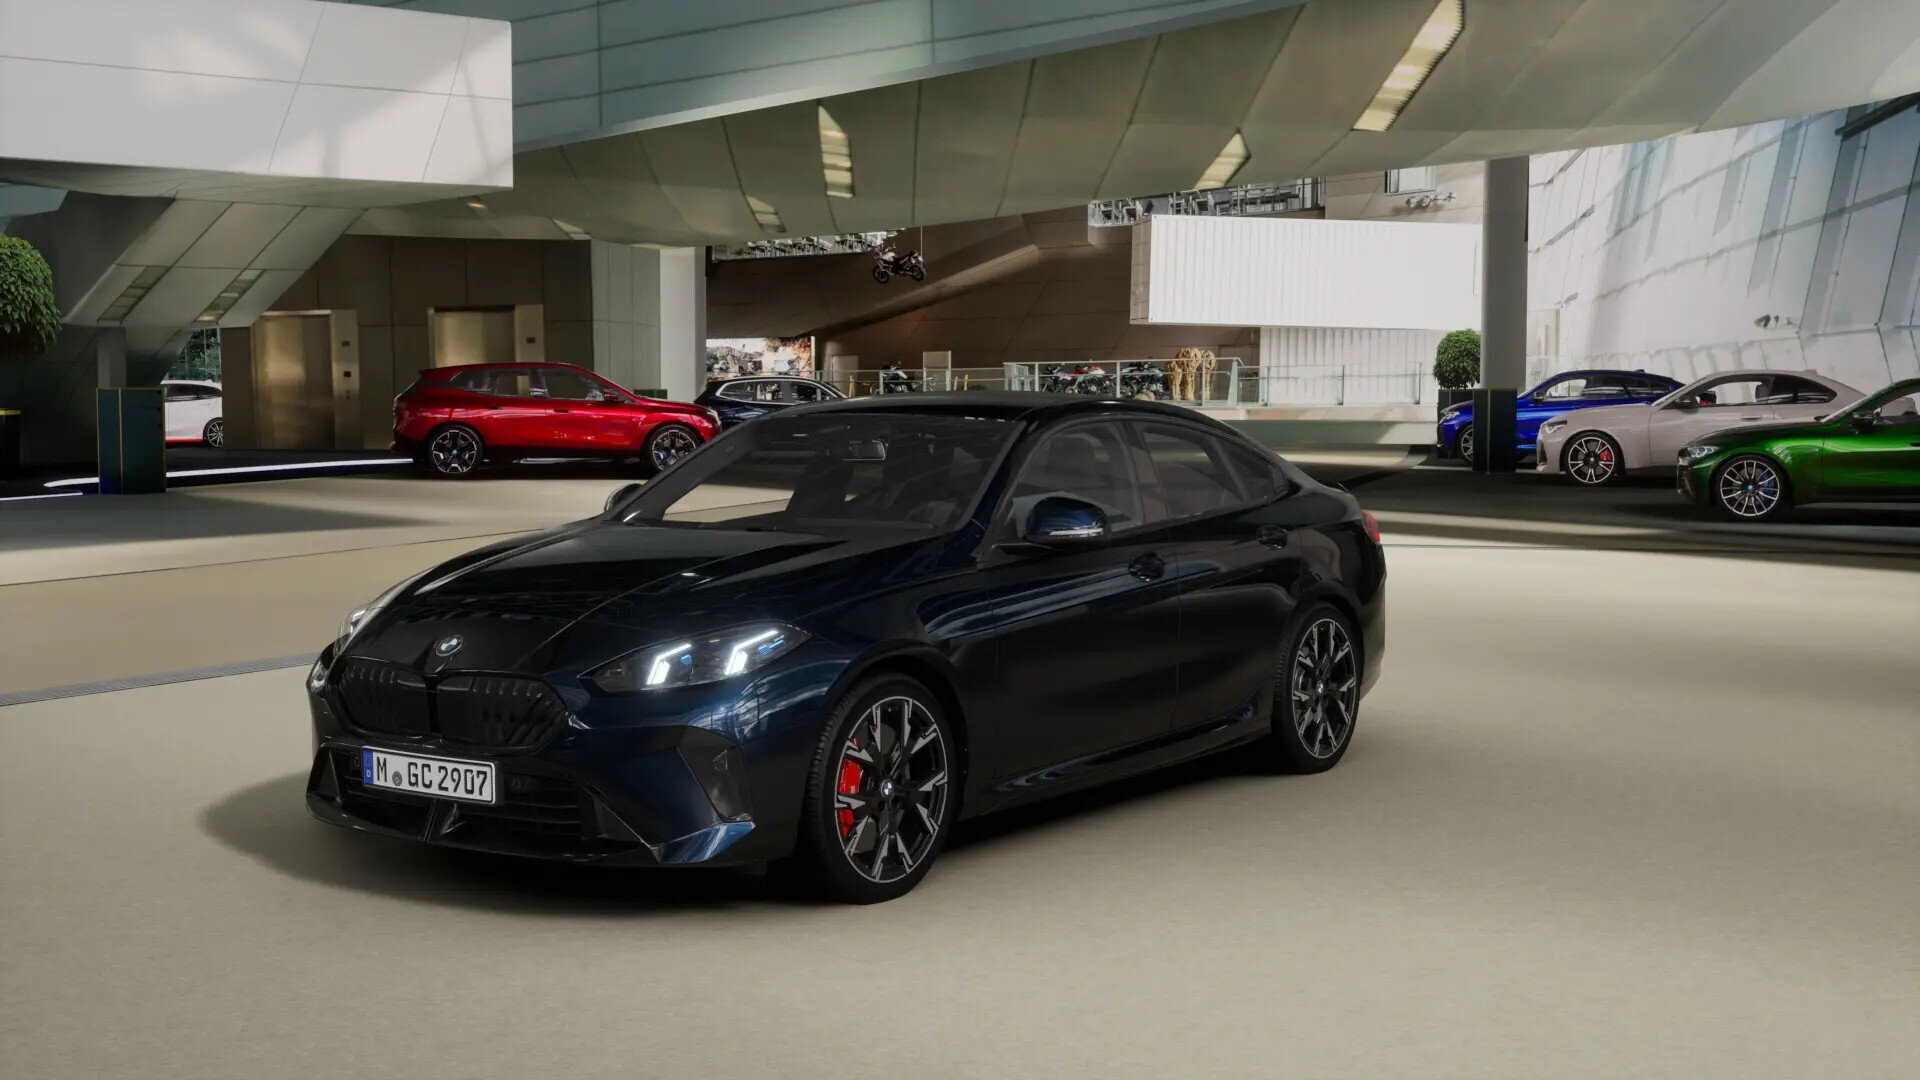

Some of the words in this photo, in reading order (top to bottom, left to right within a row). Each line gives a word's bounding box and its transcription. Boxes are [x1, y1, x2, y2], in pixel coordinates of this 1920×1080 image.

[366, 769, 371, 778] D
[376, 756, 388, 783] M
[407, 761, 433, 789] GC
[437, 765, 488, 796] 2907
